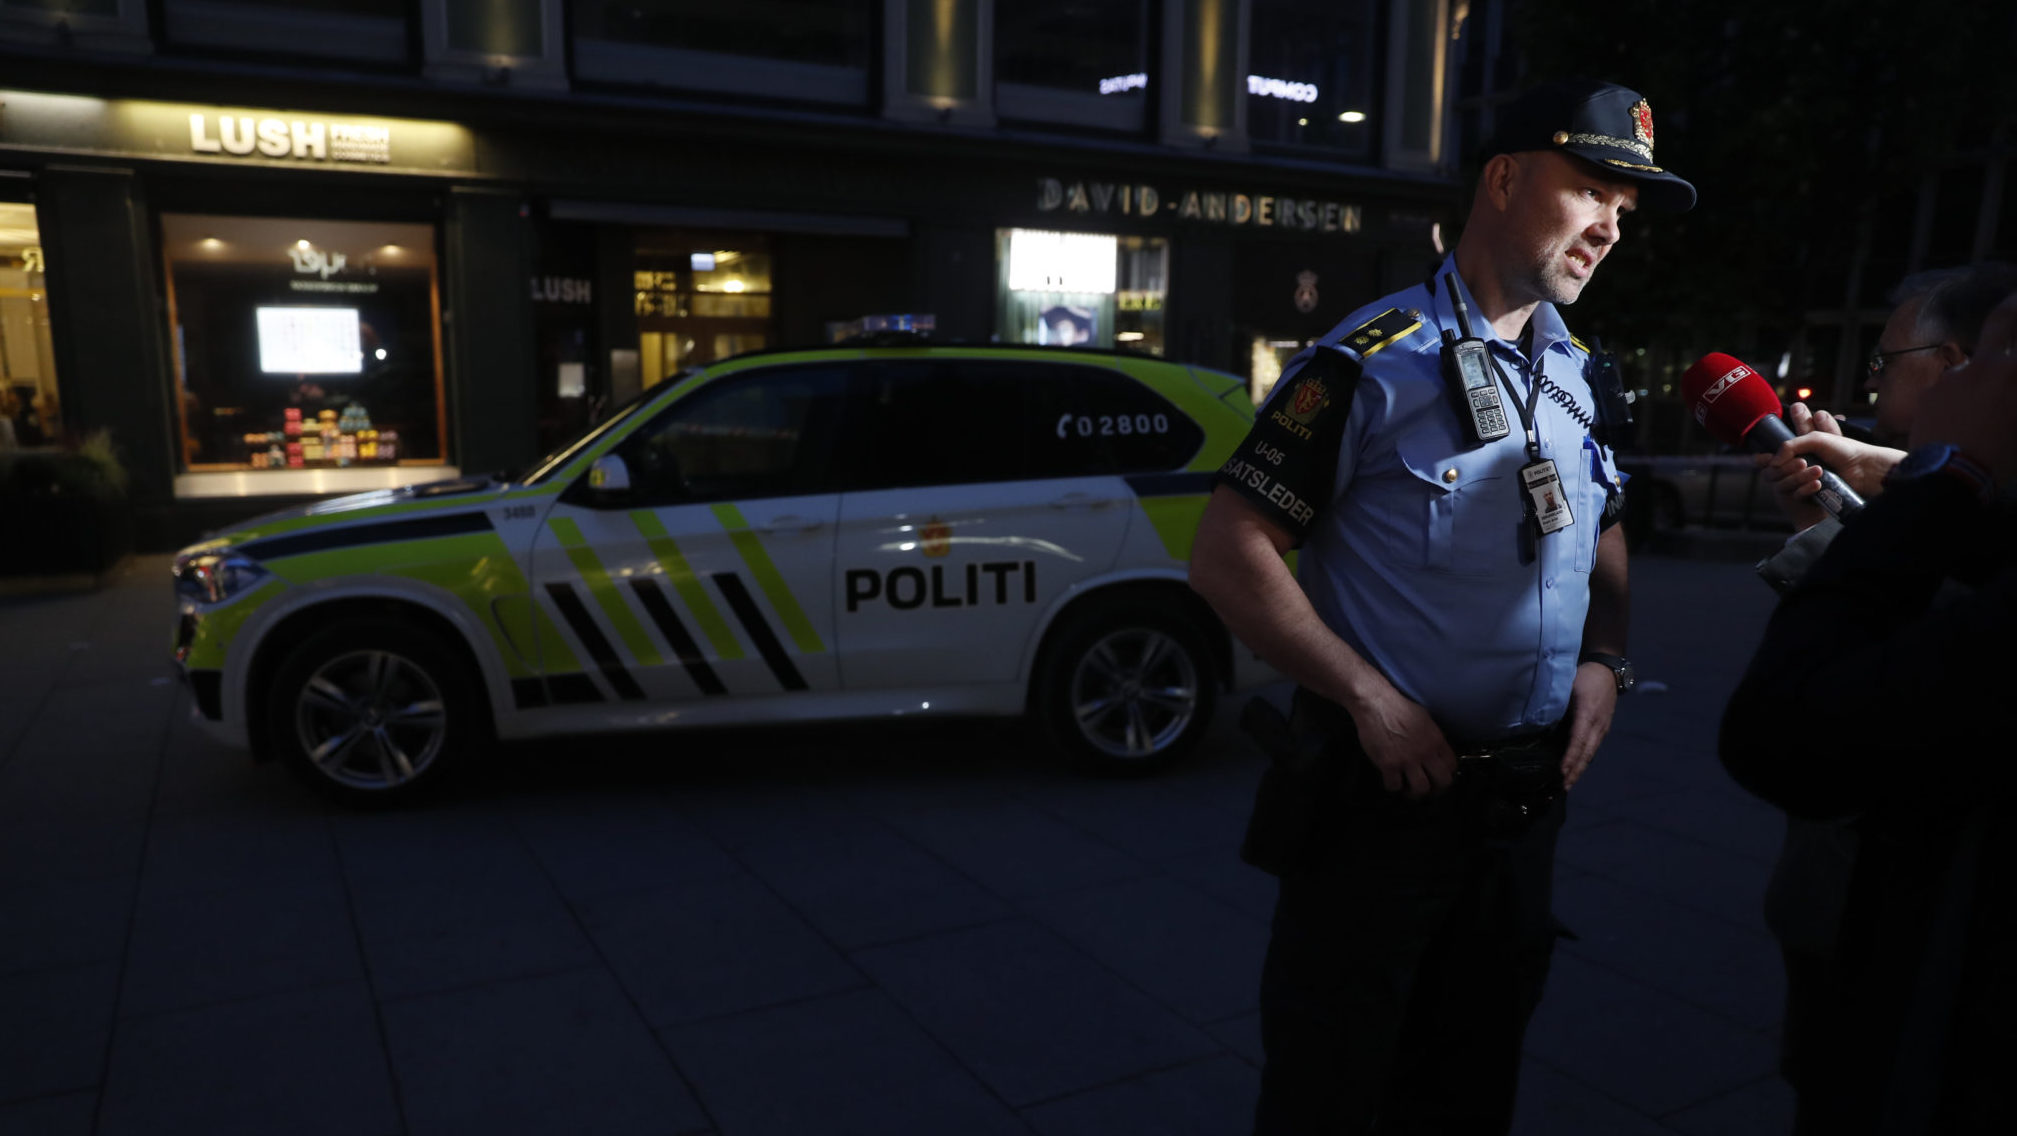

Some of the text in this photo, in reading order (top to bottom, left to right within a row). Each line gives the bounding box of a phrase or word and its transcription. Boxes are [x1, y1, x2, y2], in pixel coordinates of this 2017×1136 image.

[189, 113, 326, 158] LUSH
[530, 274, 592, 304] LUSH
[1707, 367, 1747, 397] VG
[1077, 413, 1169, 437] 02800
[1271, 410, 1313, 441] POLITI
[1255, 440, 1286, 466] U-05
[845, 560, 1036, 613] POLITI
